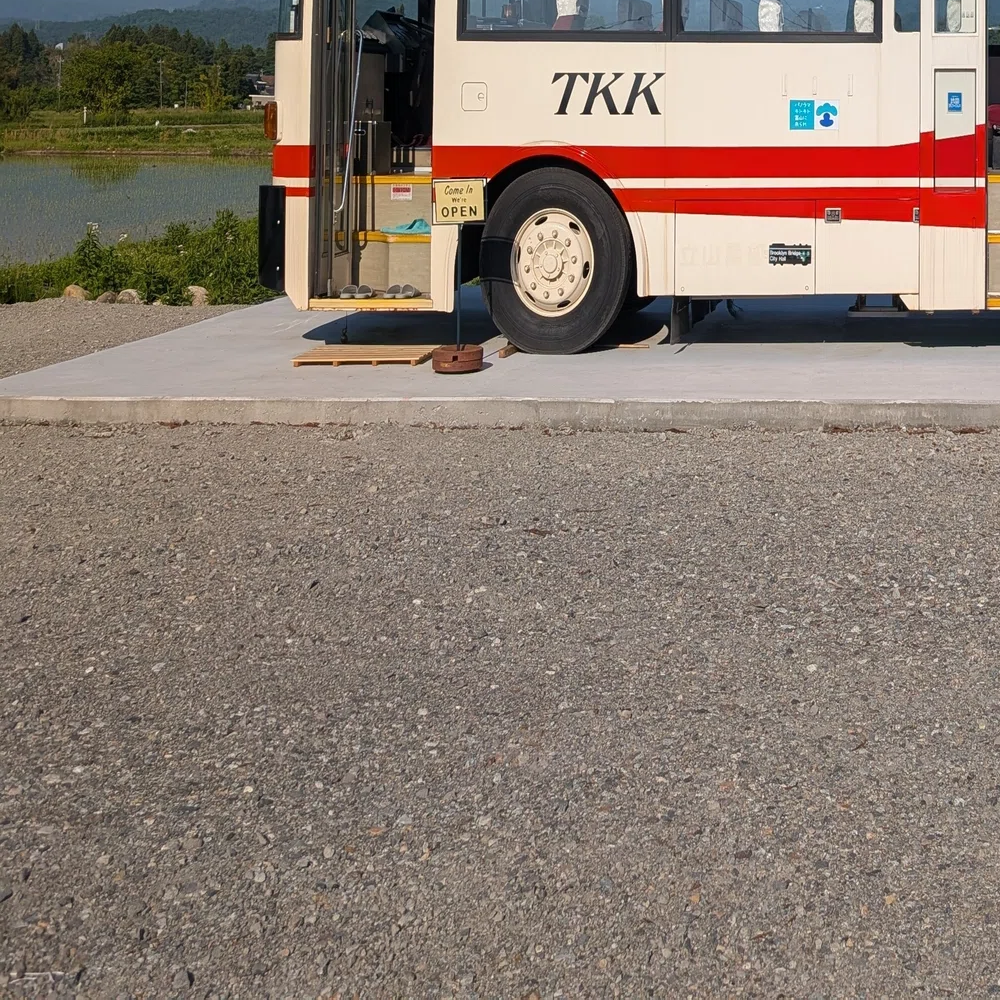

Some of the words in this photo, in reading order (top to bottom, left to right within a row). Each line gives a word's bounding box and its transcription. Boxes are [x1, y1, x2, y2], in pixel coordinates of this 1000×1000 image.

[551, 72, 667, 115] TKK
[444, 185, 464, 195] Come
[466, 184, 474, 194] In
[441, 205, 477, 218] OPEN
